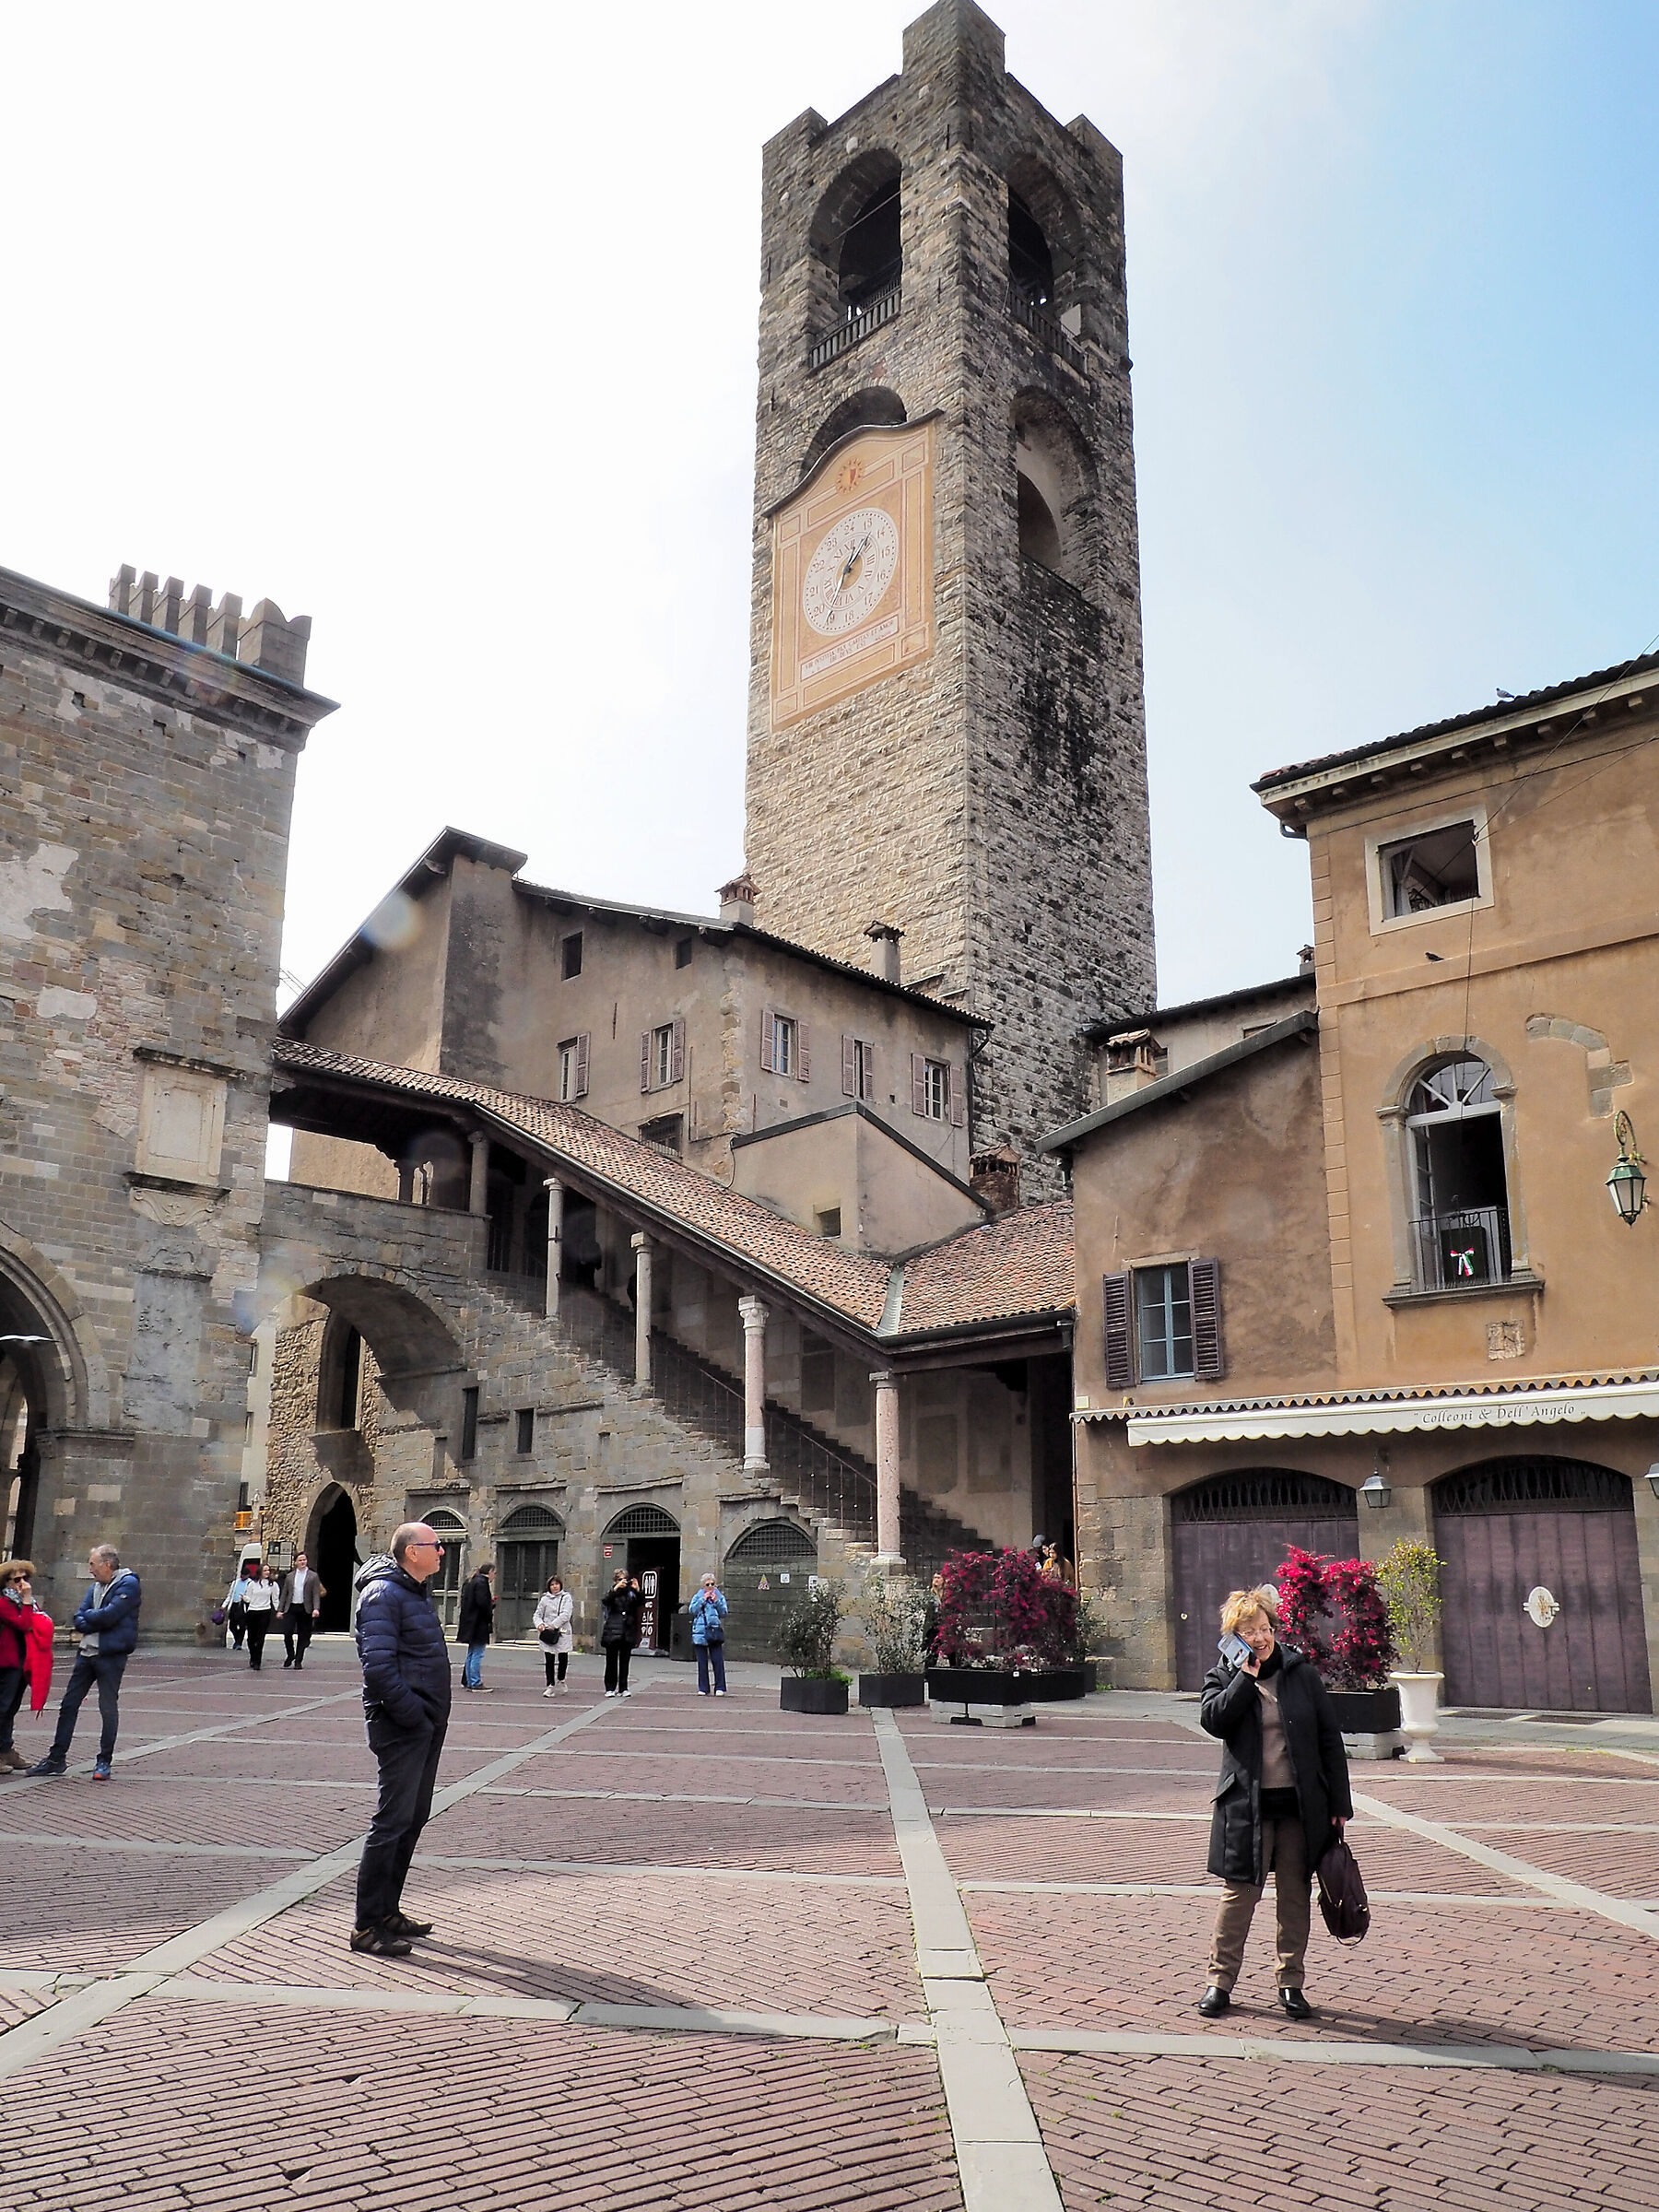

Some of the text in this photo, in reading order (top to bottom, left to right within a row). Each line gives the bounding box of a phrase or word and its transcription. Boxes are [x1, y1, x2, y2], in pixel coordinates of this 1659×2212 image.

[844, 521, 855, 535] 24
[864, 518, 873, 531] 13
[877, 526, 886, 539] 14
[825, 537, 838, 551] 23
[881, 546, 890, 559] 15
[813, 559, 825, 573] 22
[877, 571, 886, 582] 16
[809, 585, 818, 597] 21
[865, 592, 874, 606] 17
[814, 604, 825, 618] 20
[845, 610, 854, 623] 18
[1422, 1409, 1473, 1424] Colleoni
[1478, 1408, 1492, 1419] &
